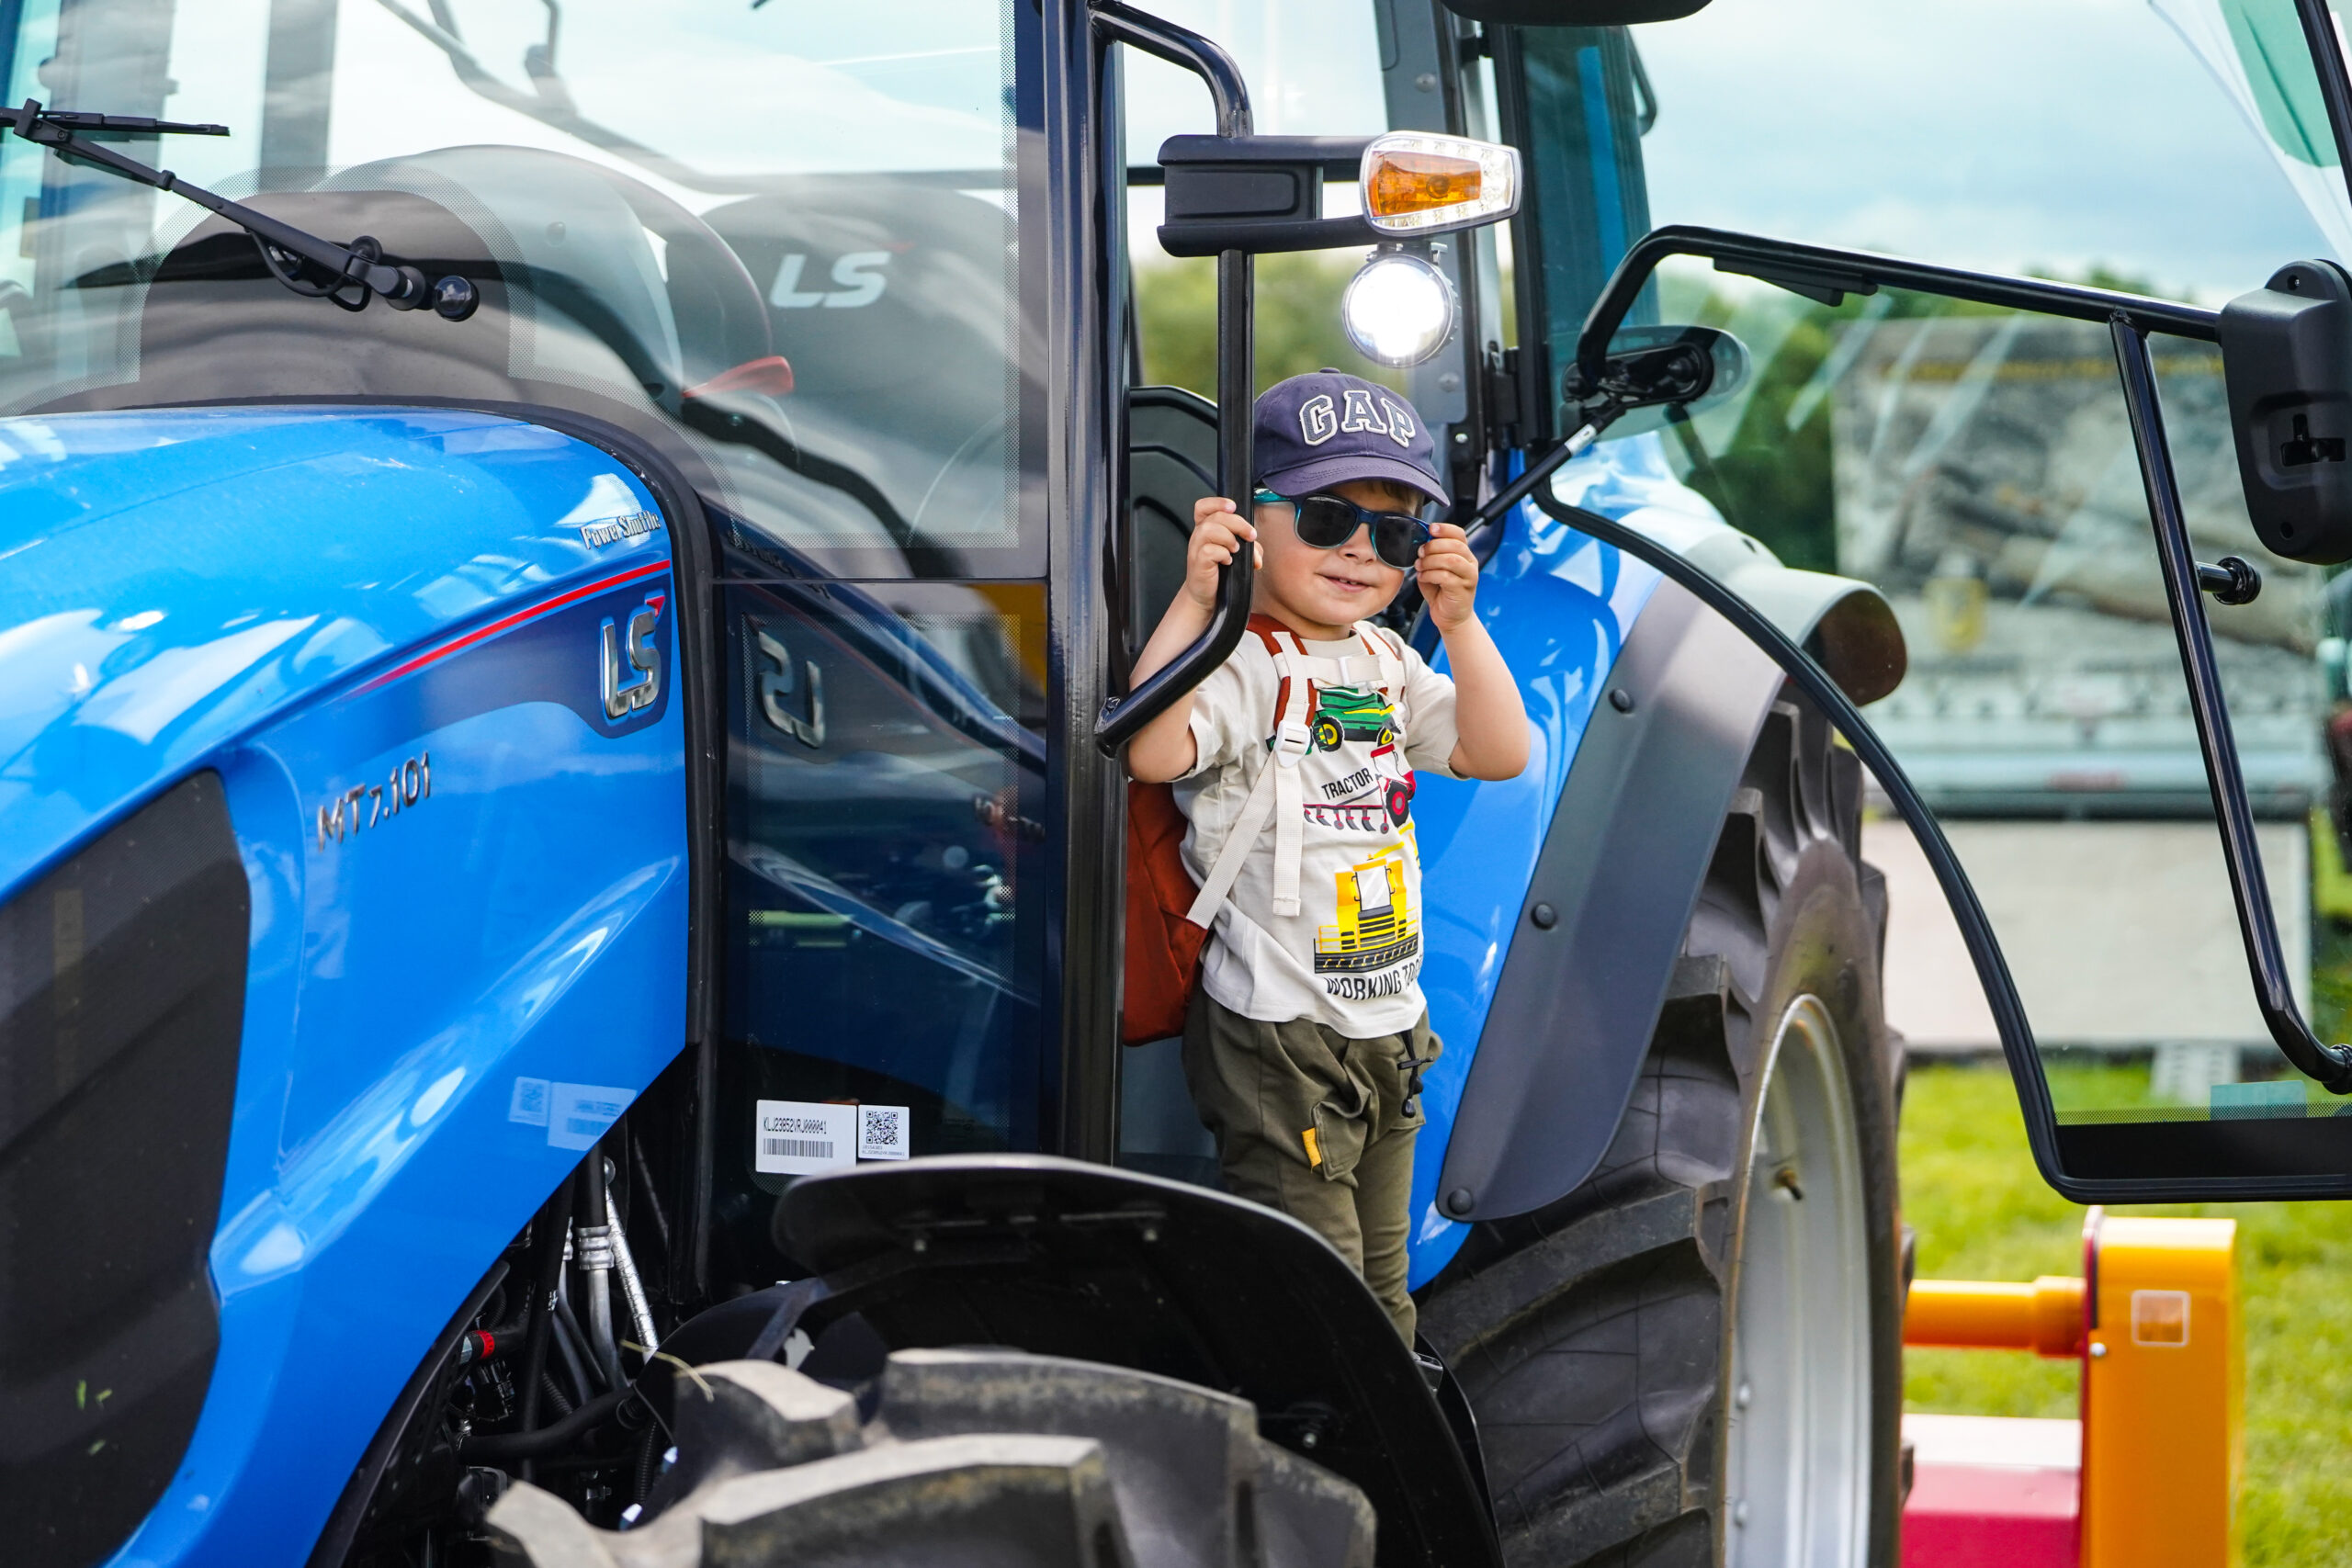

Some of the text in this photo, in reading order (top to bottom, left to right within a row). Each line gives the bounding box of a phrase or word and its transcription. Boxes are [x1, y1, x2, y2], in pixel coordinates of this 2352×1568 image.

[769, 252, 891, 308] LS
[1299, 390, 1416, 448] GAP
[603, 610, 662, 719] LS
[1321, 767, 1374, 800] TRACTOR
[1323, 970, 1402, 1000] WORKING
